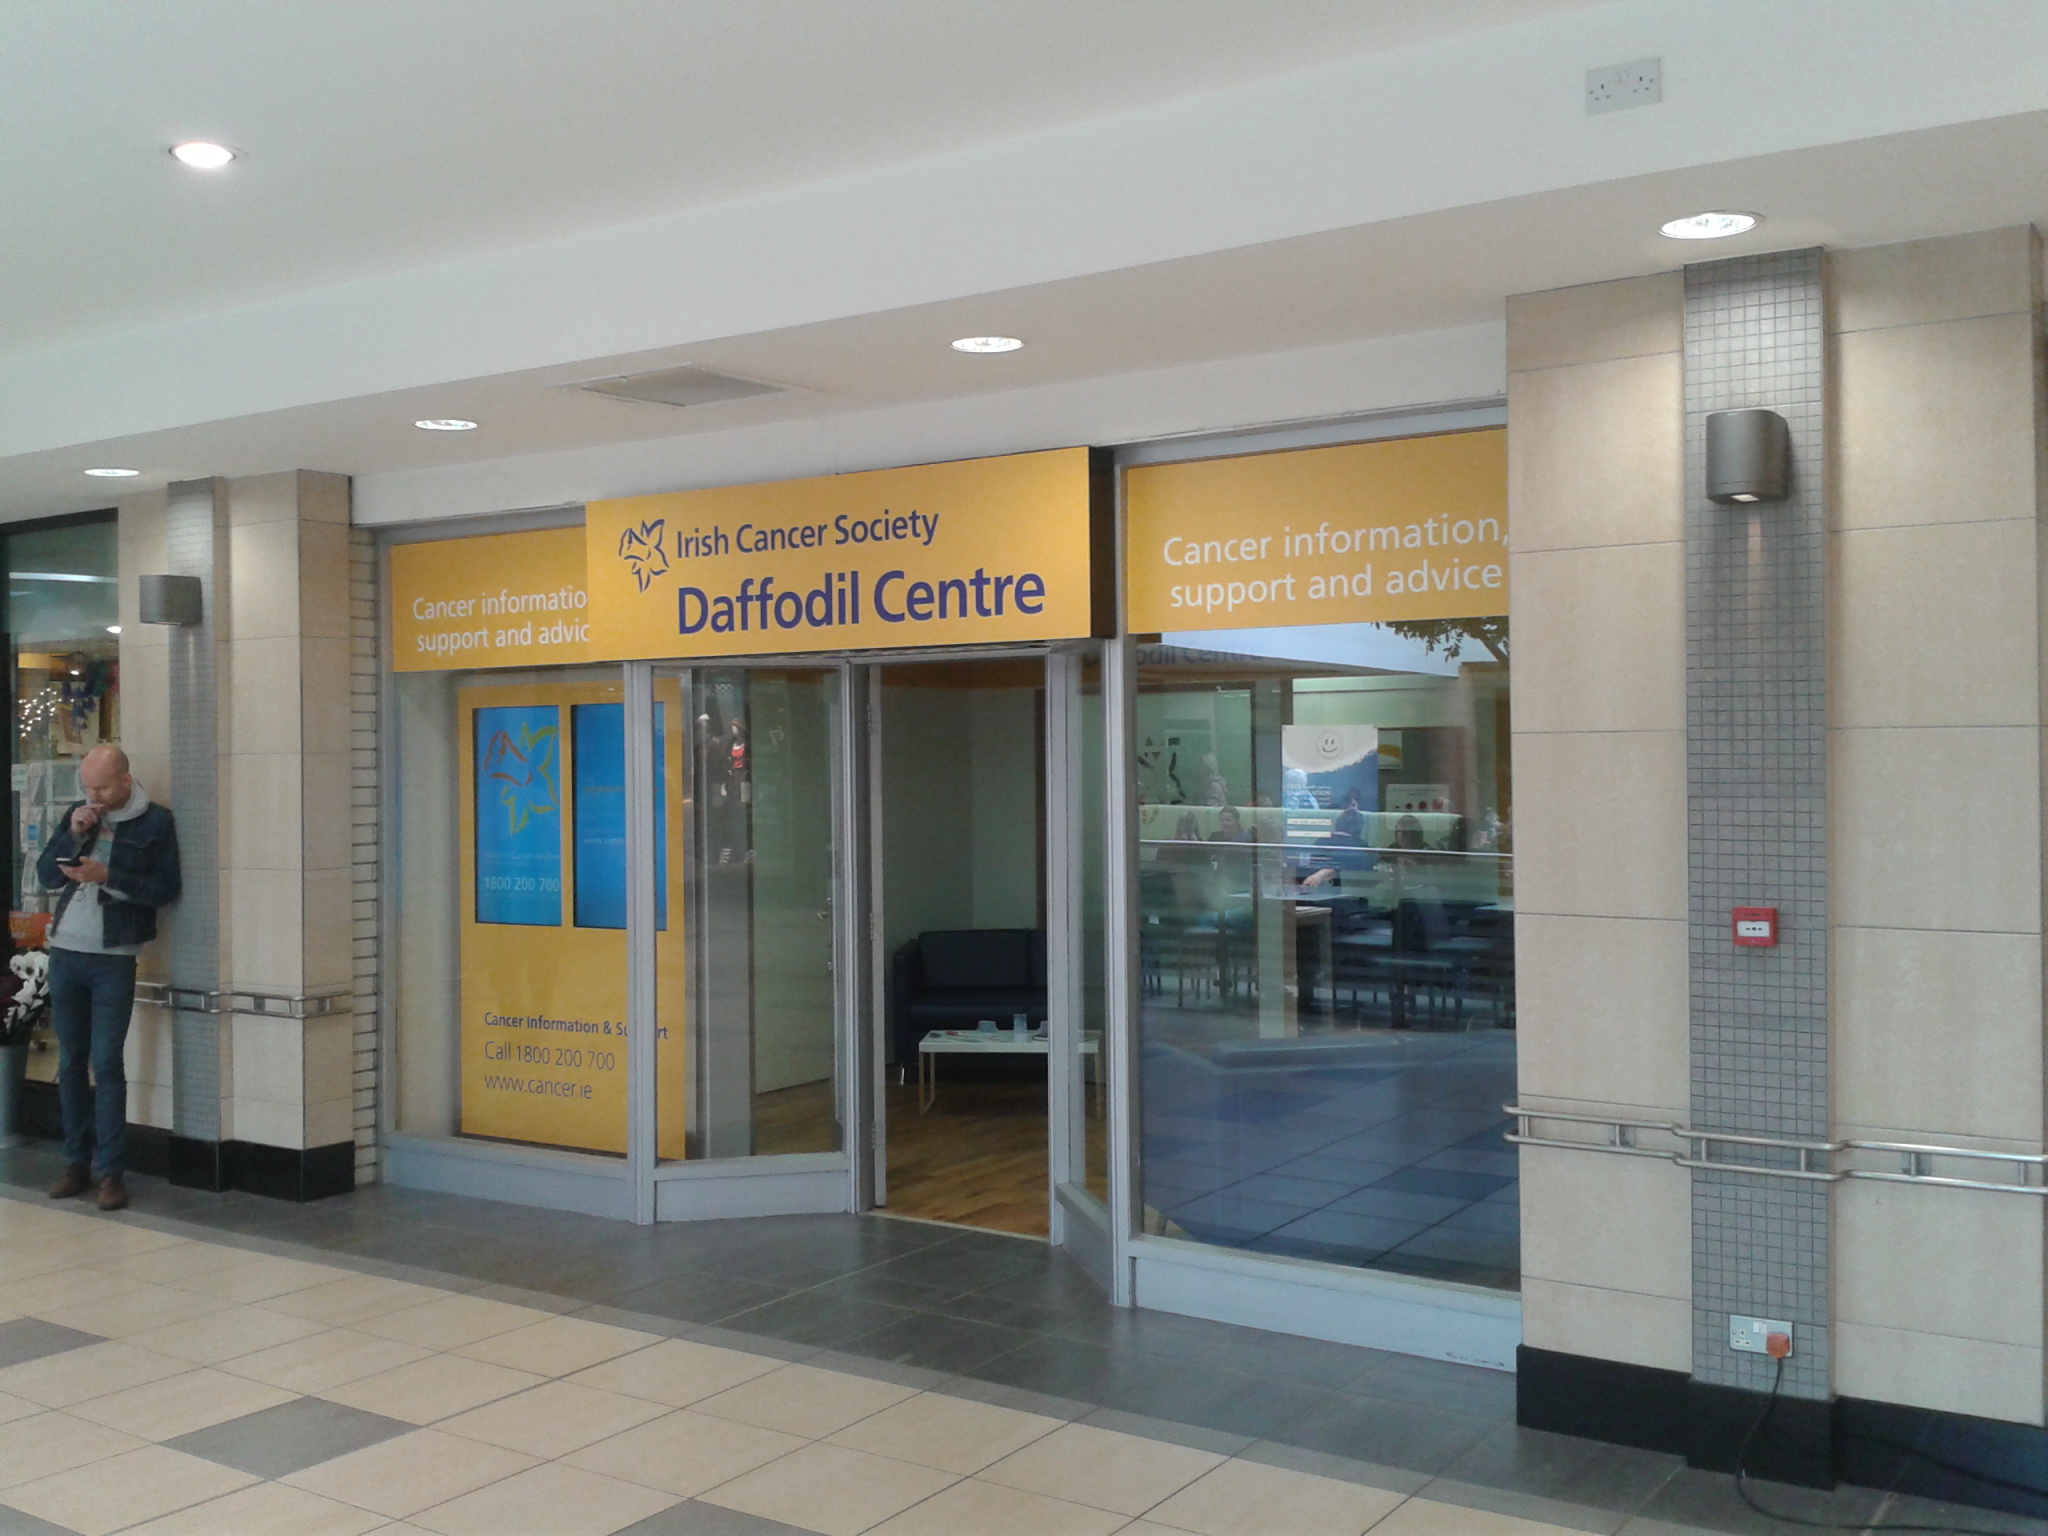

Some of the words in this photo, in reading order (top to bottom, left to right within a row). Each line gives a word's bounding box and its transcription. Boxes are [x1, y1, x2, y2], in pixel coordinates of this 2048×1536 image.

[676, 525, 729, 559] Irish
[736, 522, 828, 553] Cancer
[834, 509, 940, 546] Society
[1163, 536, 1272, 566] Cancer
[1284, 513, 1509, 557] information,
[413, 597, 475, 620] Cancer
[482, 585, 588, 615] informatio
[678, 570, 860, 635] Daffodil
[873, 567, 1046, 623] Centre
[1170, 572, 1296, 614] support
[1308, 563, 1372, 599] and
[1386, 558, 1503, 596] advice
[417, 627, 489, 657] support
[495, 620, 532, 647] and
[538, 618, 590, 645] advic
[484, 876, 511, 891] 1800
[514, 877, 535, 892] 200
[539, 877, 561, 893] 700
[484, 1012, 524, 1028] Cancer
[527, 1015, 599, 1034] Information
[603, 1020, 612, 1035] &
[484, 1041, 511, 1060] Call
[517, 1045, 551, 1064] 1800
[555, 1048, 582, 1068] 200
[588, 1051, 615, 1071] 700
[484, 1074, 592, 1099] www.cancer.ie
